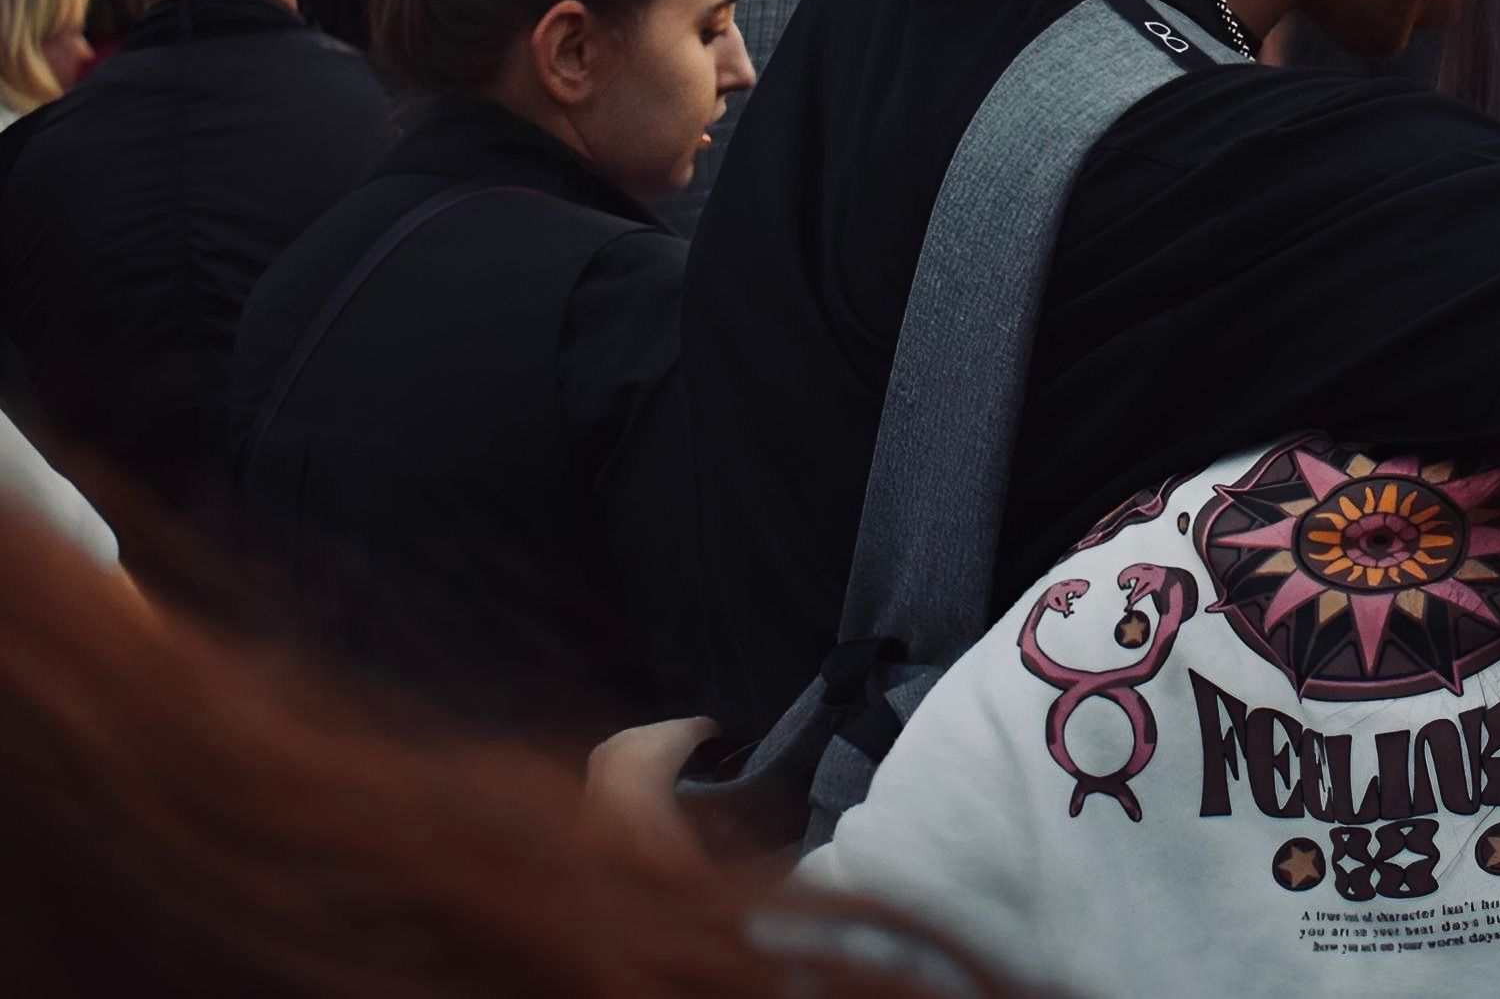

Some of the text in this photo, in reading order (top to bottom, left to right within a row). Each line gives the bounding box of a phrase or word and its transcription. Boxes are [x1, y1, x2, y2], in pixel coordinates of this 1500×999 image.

[1301, 911, 1310, 921] A
[1377, 909, 1435, 922] character
[1427, 936, 1464, 948] worst
